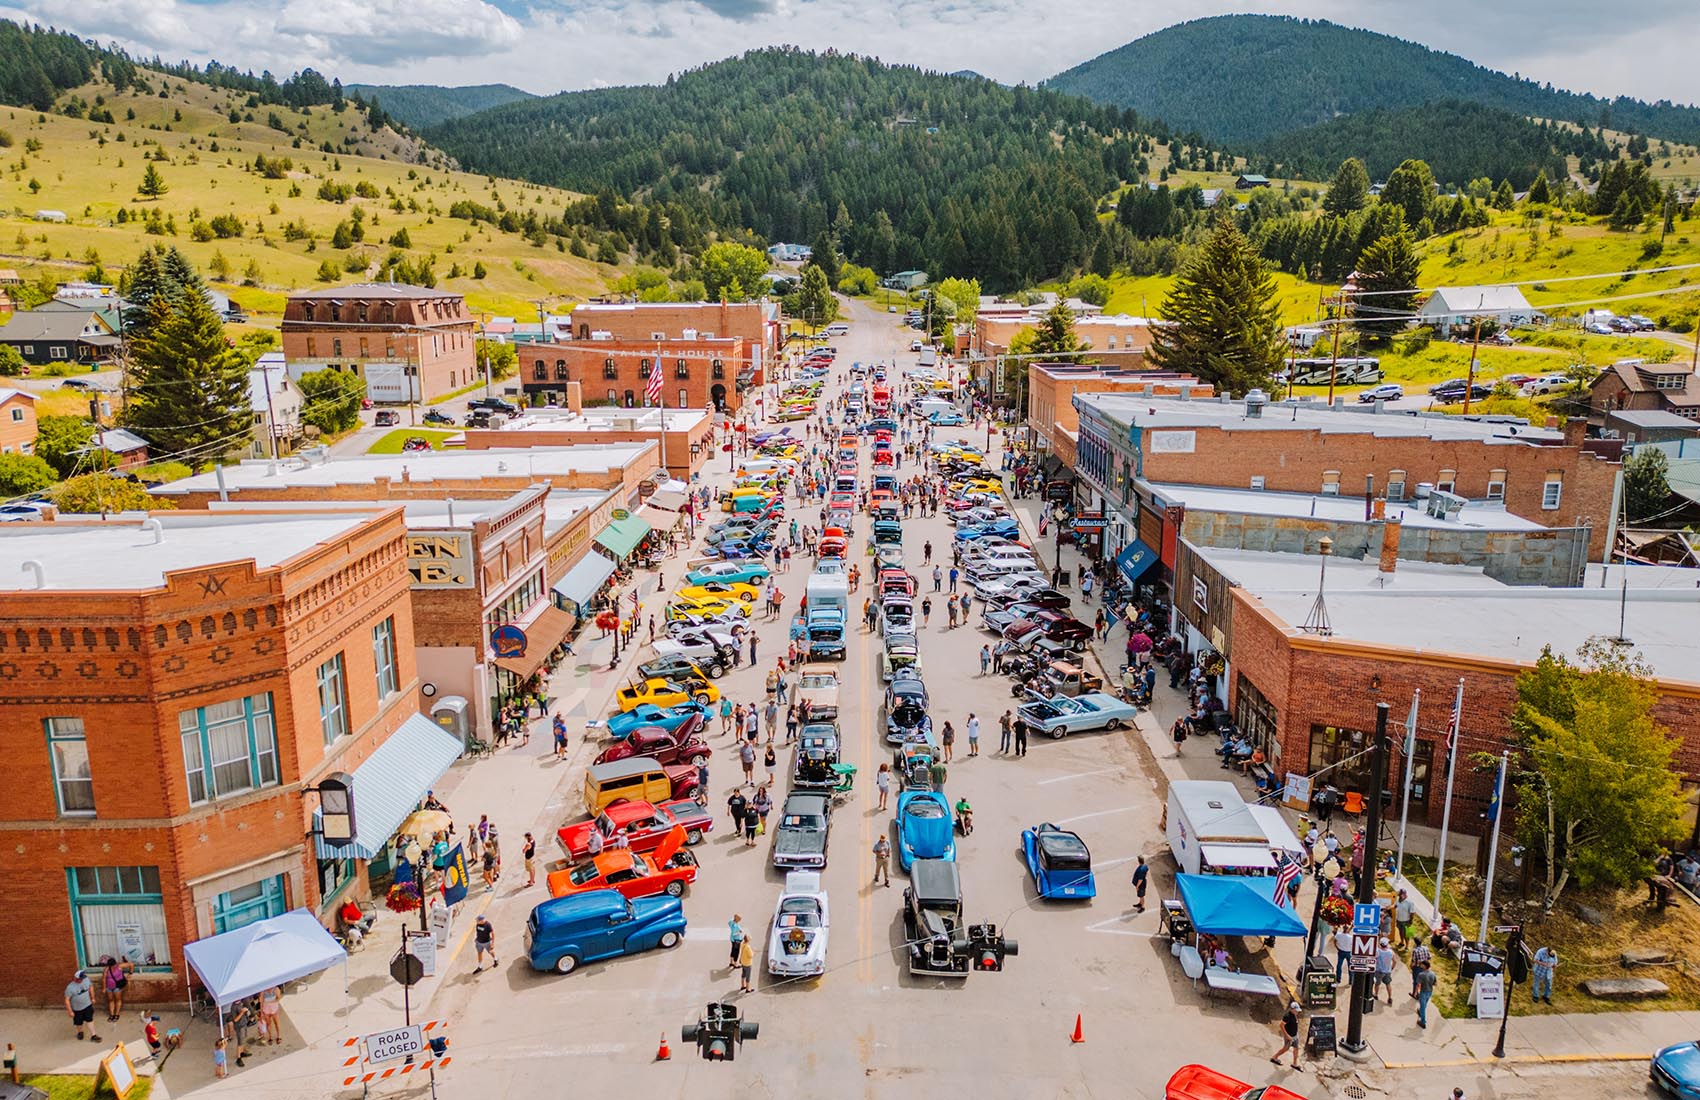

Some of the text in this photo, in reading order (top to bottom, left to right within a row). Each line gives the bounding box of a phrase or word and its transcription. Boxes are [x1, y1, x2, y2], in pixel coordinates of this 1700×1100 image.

[456, 853, 468, 888] MONTANA
[1359, 907, 1375, 924] H
[1354, 936, 1375, 955] M
[378, 1031, 409, 1045] ROAD
[374, 1041, 418, 1059] CLOSED
